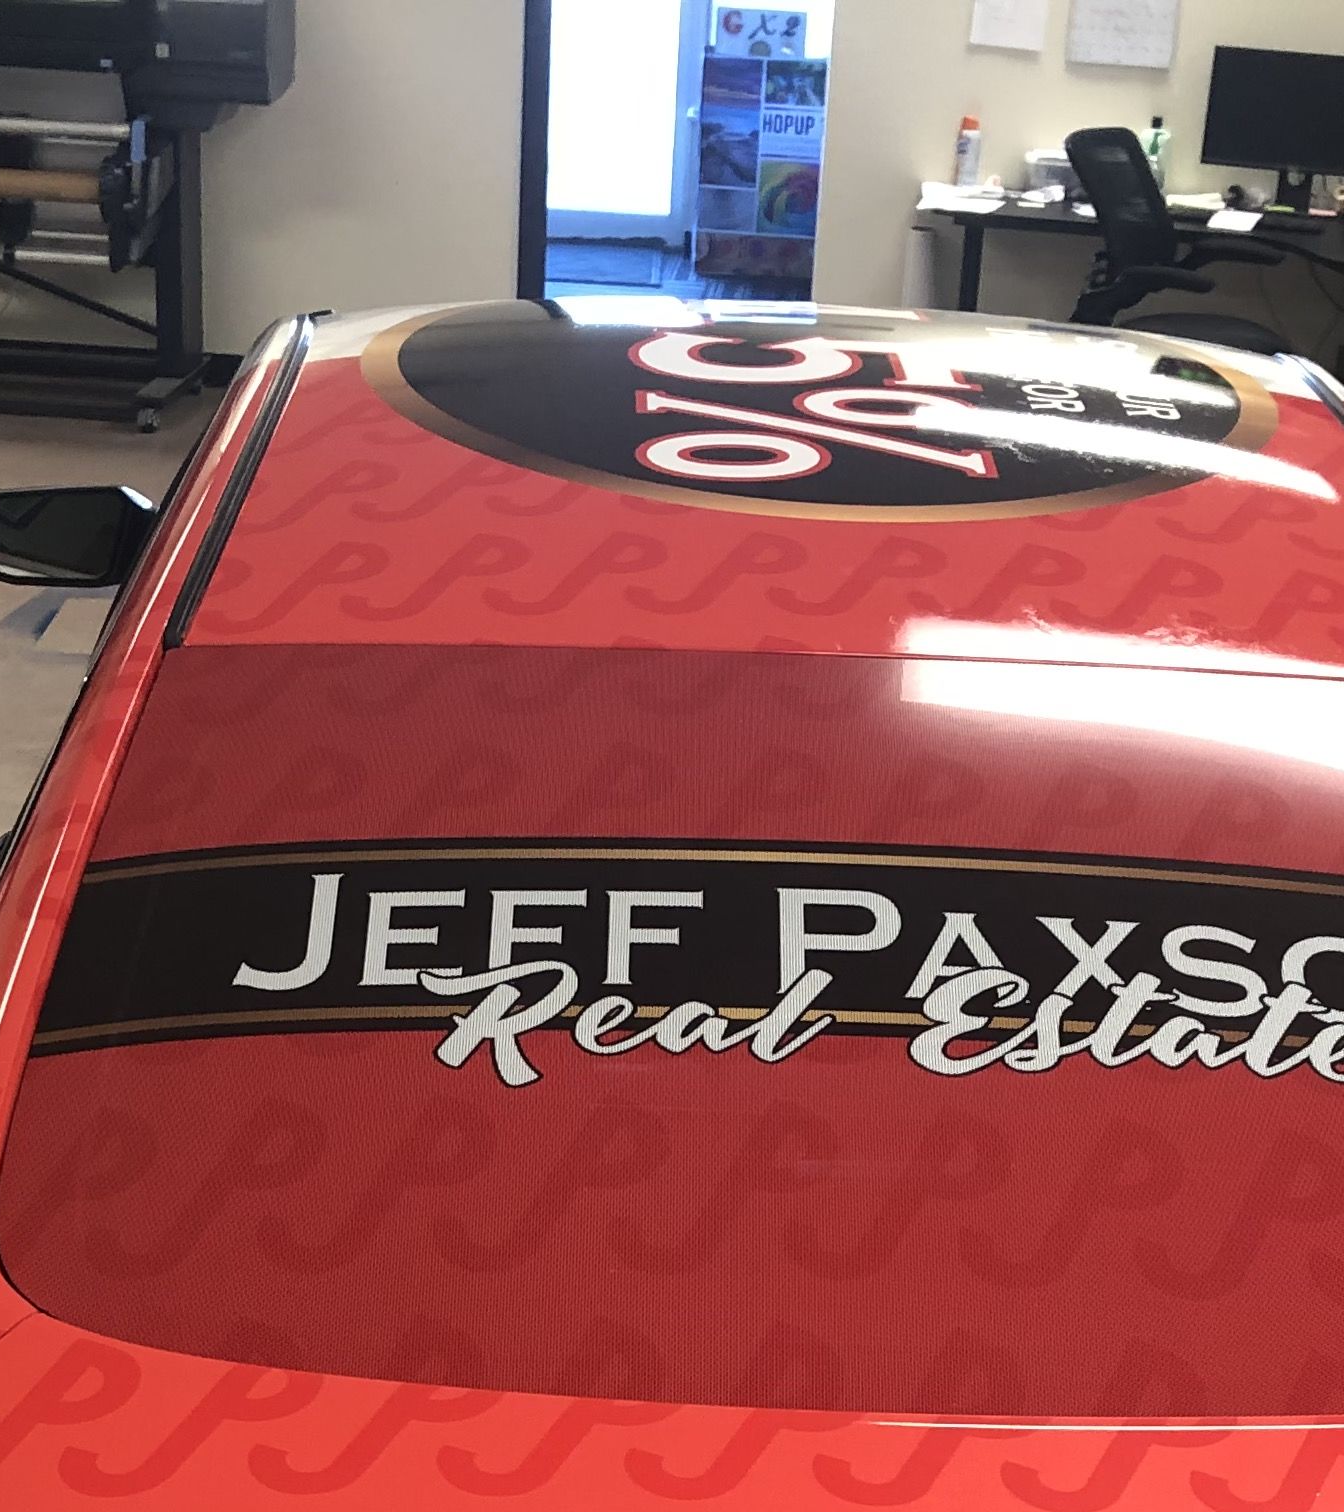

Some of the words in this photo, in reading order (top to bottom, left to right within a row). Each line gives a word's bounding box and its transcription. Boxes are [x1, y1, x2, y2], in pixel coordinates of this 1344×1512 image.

[762, 114, 815, 135] HOPUP
[231, 872, 705, 992] JEFF
[417, 956, 836, 1088] Real
